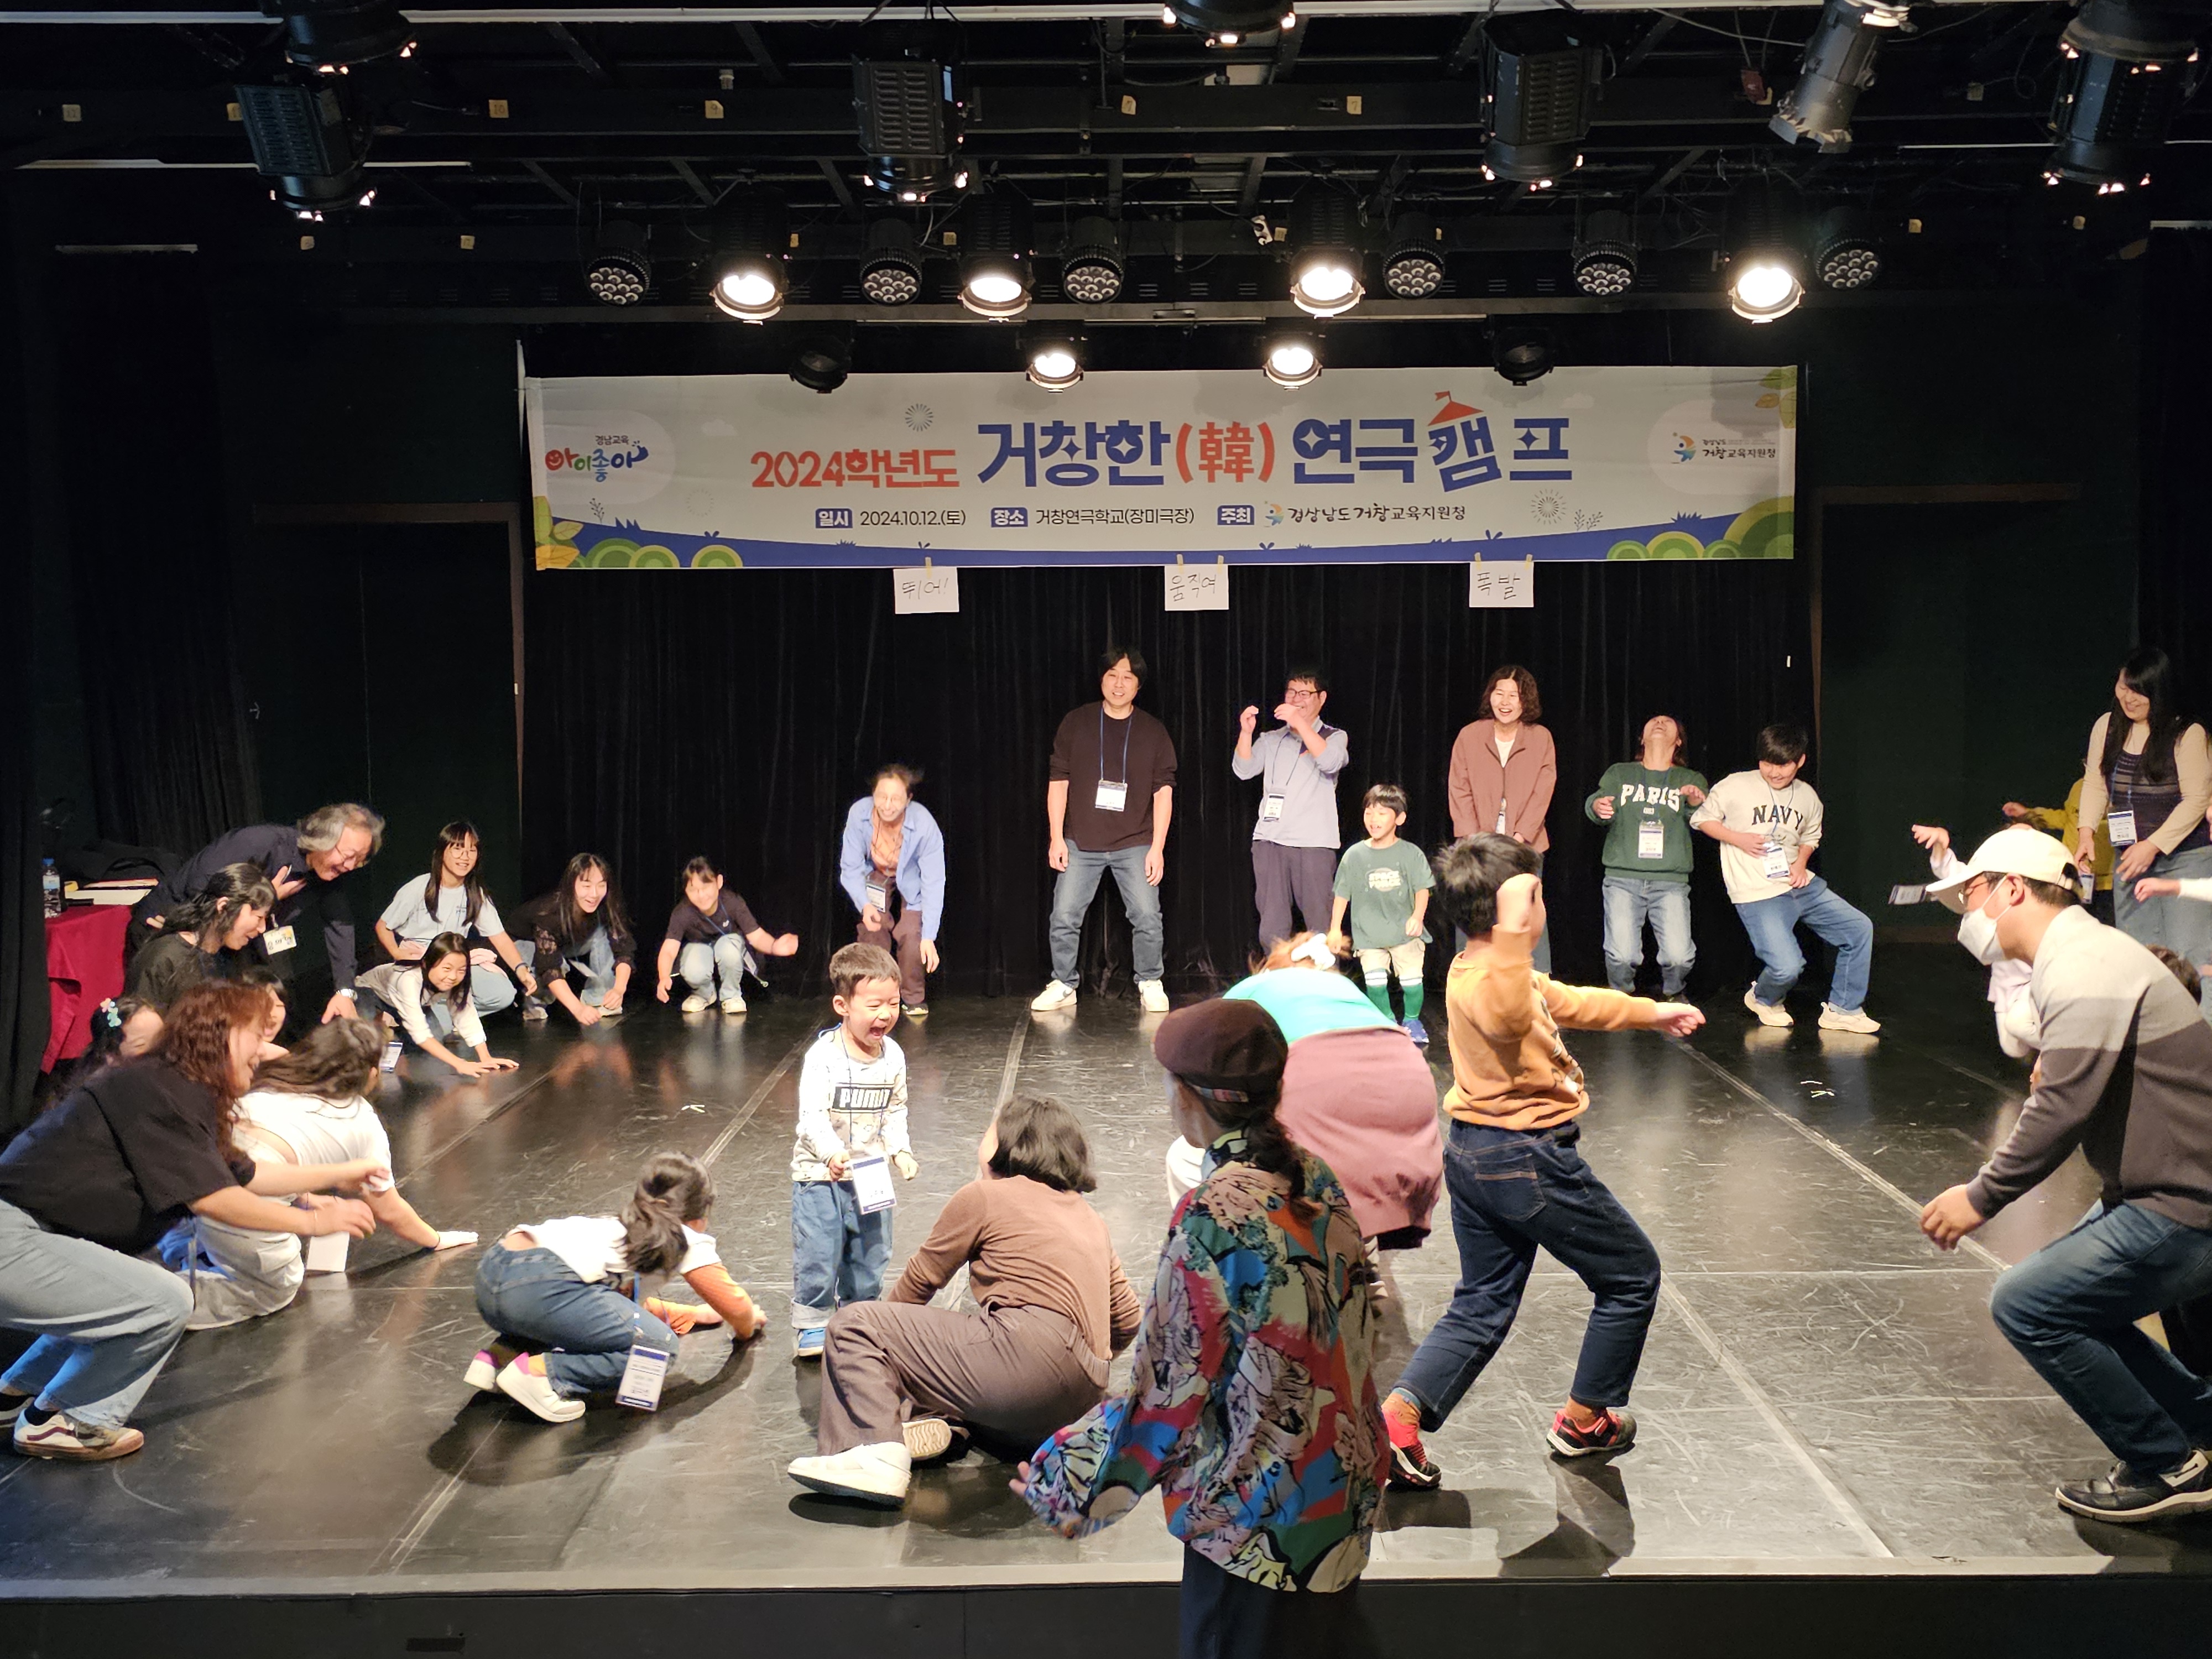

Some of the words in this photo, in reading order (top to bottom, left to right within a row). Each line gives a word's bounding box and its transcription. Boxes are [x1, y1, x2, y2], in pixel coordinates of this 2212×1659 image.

[595, 435, 629, 446] 경남교육
[750, 448, 960, 489] 2024학년도
[977, 419, 1276, 488] 거창한(韓)
[1702, 446, 1776, 459] 거창교육지원청
[545, 447, 649, 483] 아이좋아
[818, 511, 849, 527] 일시
[859, 509, 966, 526] 2024.10.12.(토)
[994, 509, 1025, 526] 장소
[1035, 508, 1194, 525] 거창연극학교(장미극장)
[1220, 507, 1251, 524] 주최
[1170, 572, 1217, 602] 움직여
[1477, 572, 1521, 600] 폭발
[1620, 784, 1680, 813] PARIS
[1751, 804, 1803, 831] NAVY
